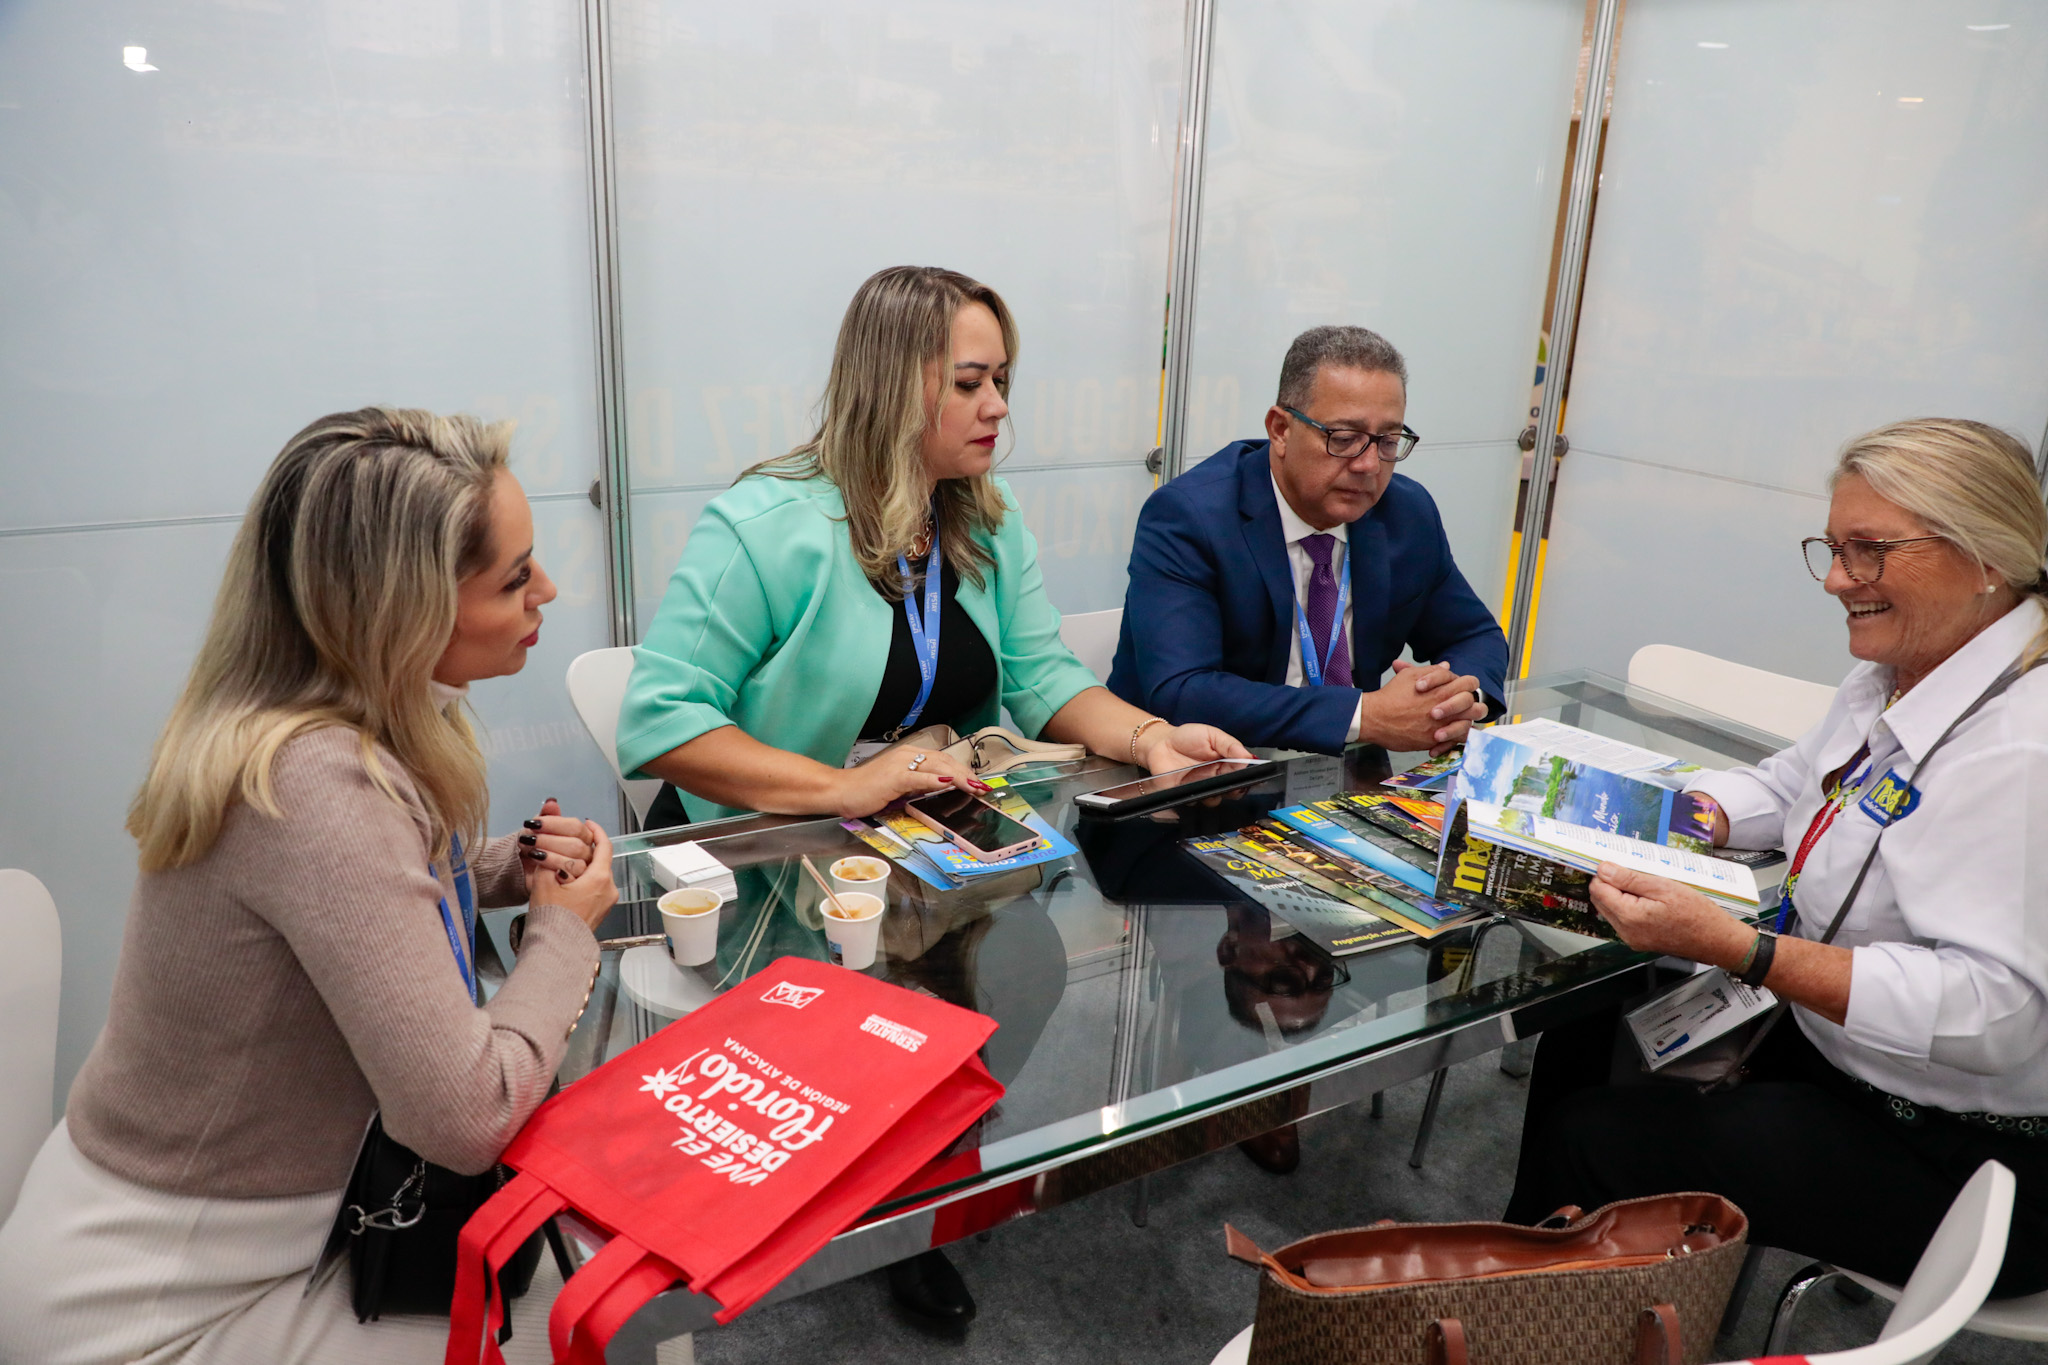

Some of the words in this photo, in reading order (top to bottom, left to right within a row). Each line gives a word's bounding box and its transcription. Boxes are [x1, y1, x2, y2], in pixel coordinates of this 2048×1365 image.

[954, 858, 1017, 869] CONHECE
[1020, 848, 1058, 862] QUEM
[859, 1016, 924, 1053] SERNATUR
[723, 1037, 783, 1079] ATACAMA
[780, 1074, 802, 1090] DE
[800, 1085, 852, 1115] REGIÓN
[664, 1094, 792, 1173] DESIERTO
[671, 1126, 713, 1156] EL
[700, 1152, 769, 1187] VIVE
